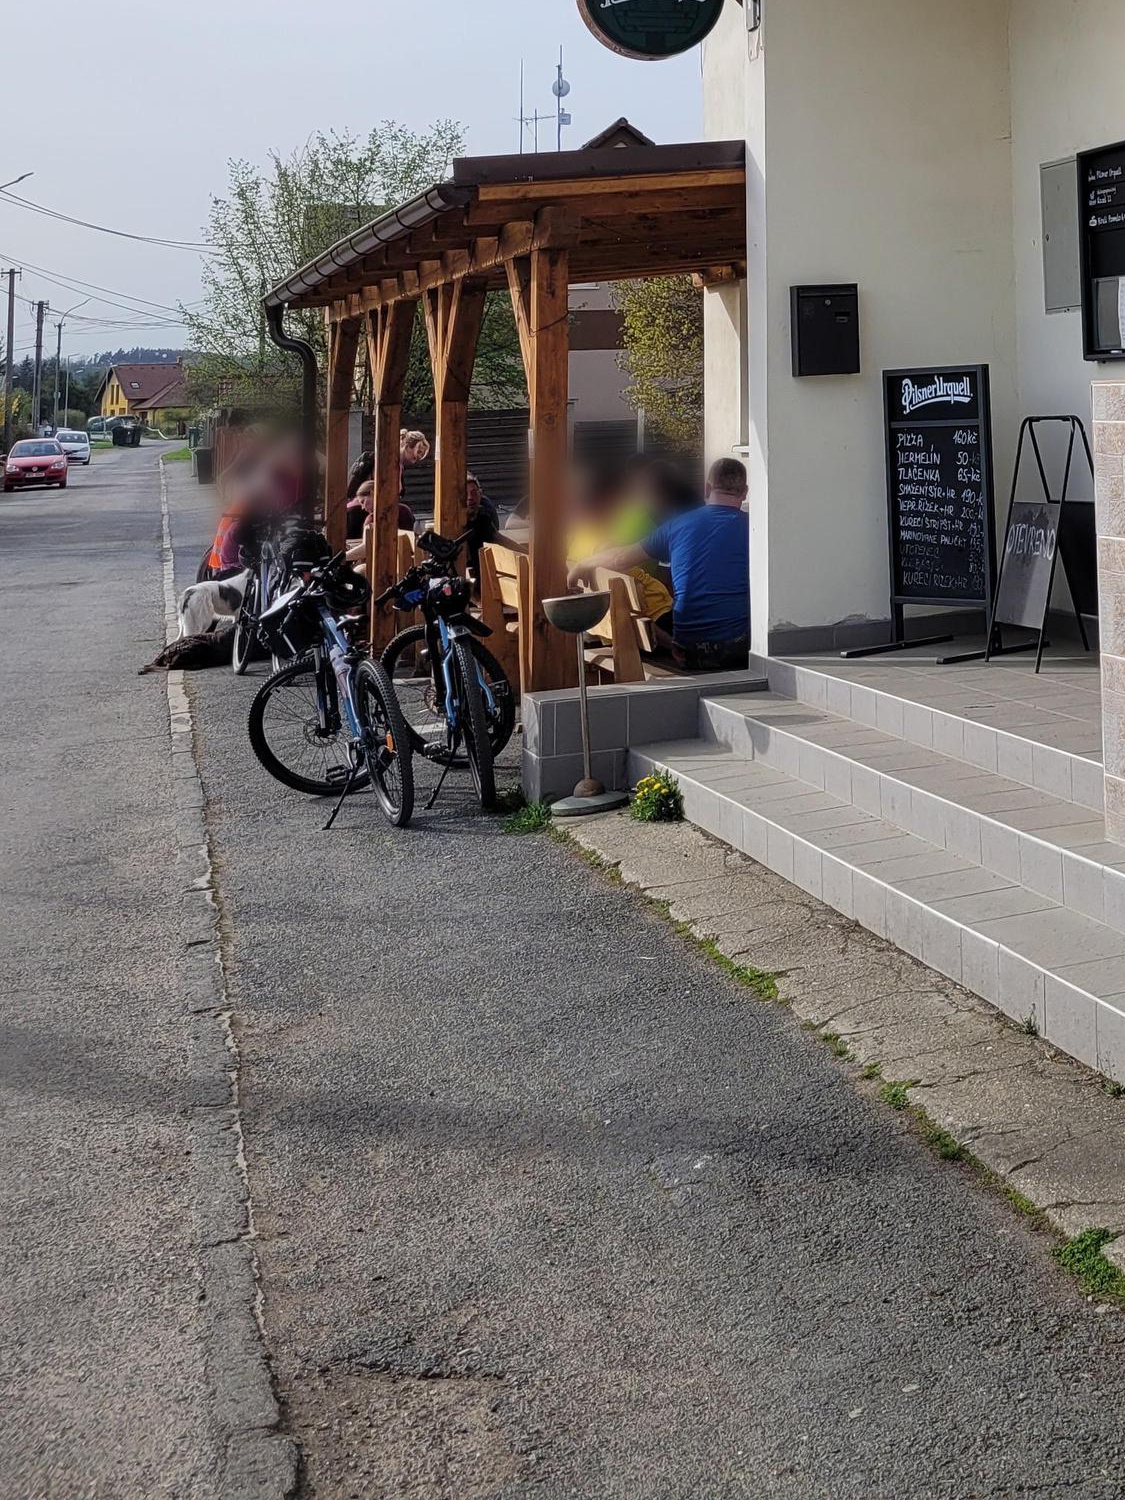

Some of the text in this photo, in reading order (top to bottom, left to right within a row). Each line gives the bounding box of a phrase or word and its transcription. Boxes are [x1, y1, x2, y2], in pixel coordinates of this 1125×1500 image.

[902, 374, 970, 415] Pilsner Urquell
[896, 432, 924, 448] PIZZA
[897, 444, 940, 466] HERMELÍN
[897, 465, 940, 482] TLAČENKA
